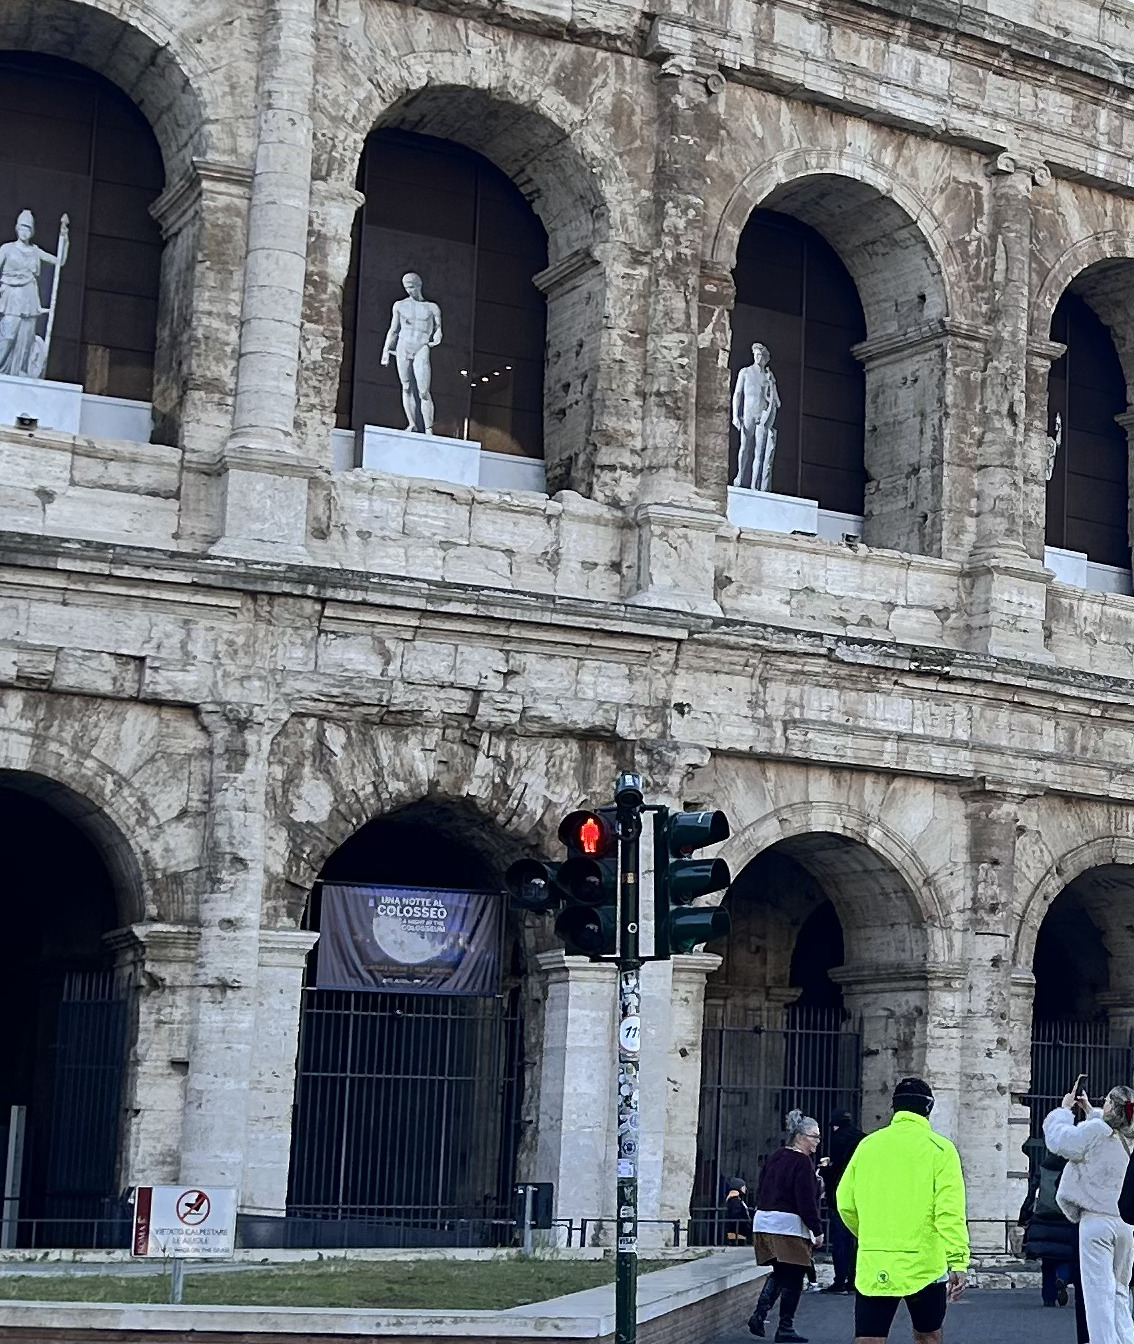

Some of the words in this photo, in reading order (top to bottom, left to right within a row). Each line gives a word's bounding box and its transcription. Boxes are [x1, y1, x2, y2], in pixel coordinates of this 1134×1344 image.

[381, 896, 400, 905] UNA
[402, 897, 431, 906] NOTTE
[433, 899, 444, 907] AL
[377, 904, 447, 919] COLOSSEO
[401, 924, 446, 933] COLOSSEUM
